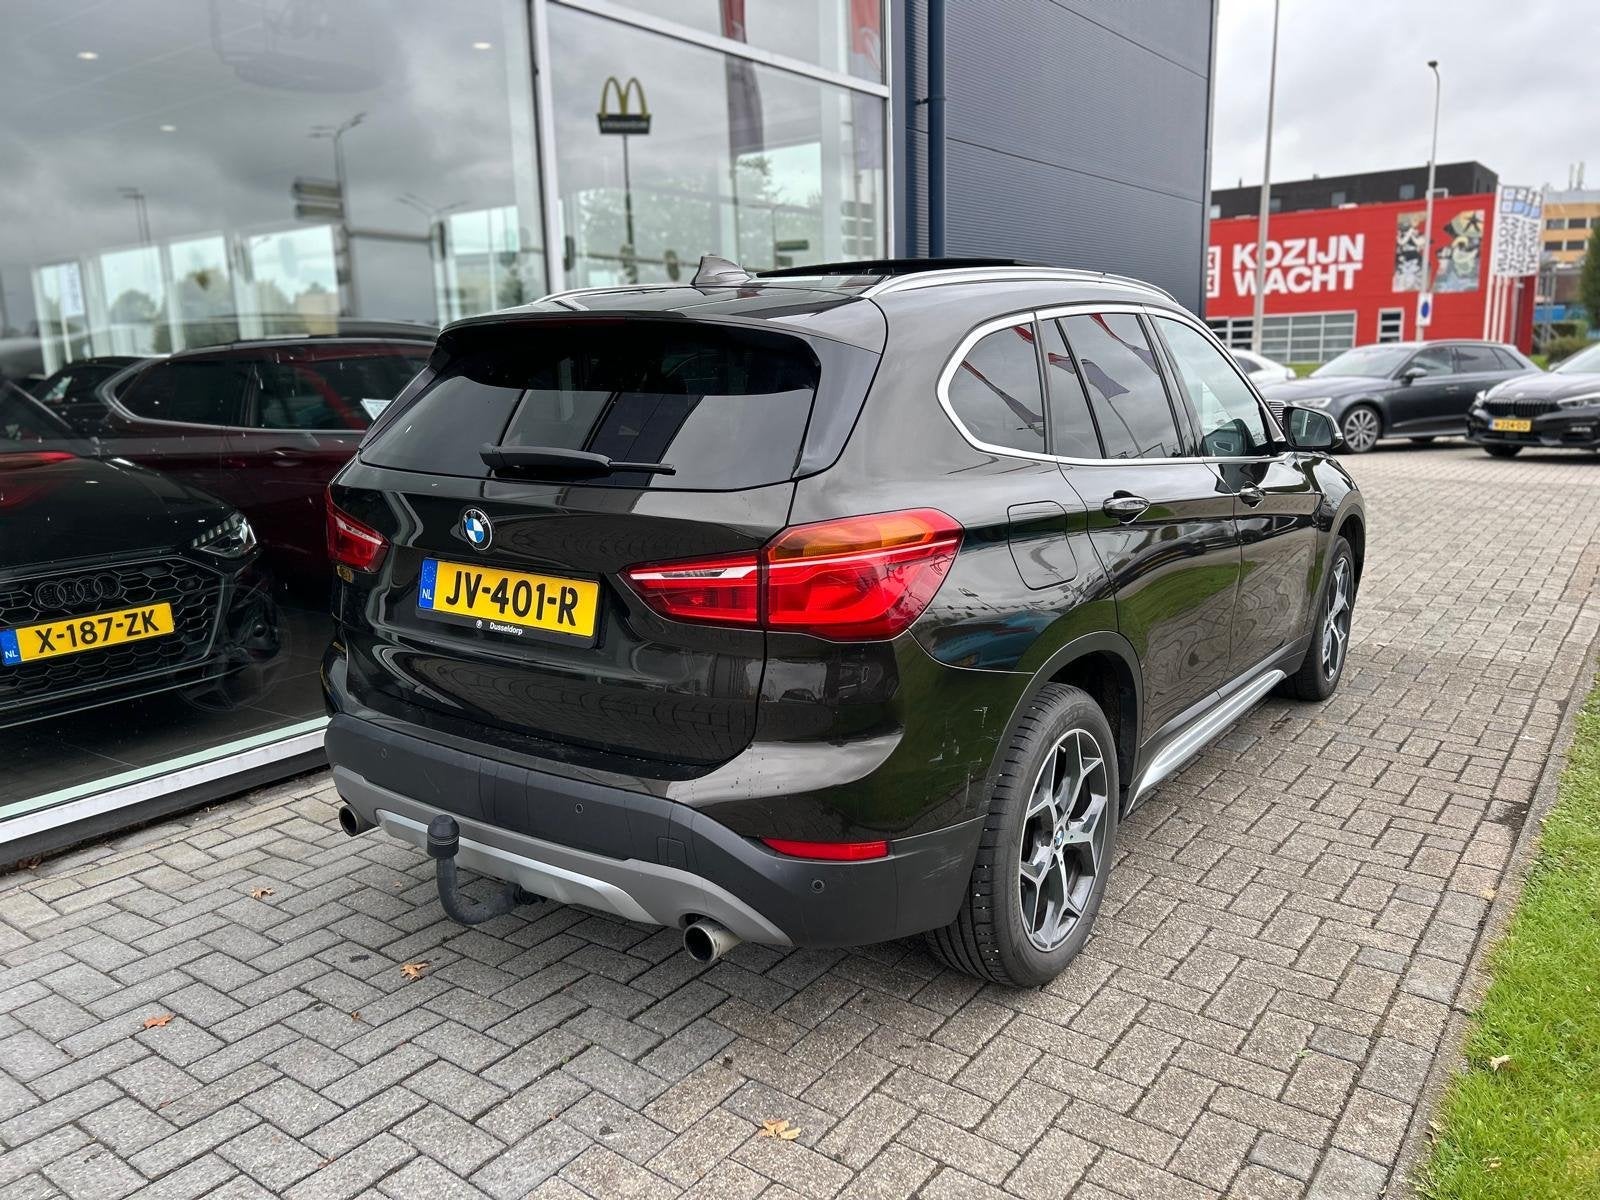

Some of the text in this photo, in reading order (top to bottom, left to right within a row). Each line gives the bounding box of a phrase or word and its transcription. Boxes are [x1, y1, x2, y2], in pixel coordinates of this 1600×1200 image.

[1232, 233, 1365, 270] KOZIJN
[1232, 262, 1364, 297] WACHT
[422, 570, 579, 627] NL JV-401-R
[5, 609, 160, 659] NL X-187-ZK
[489, 620, 523, 636] Dusseldorp
